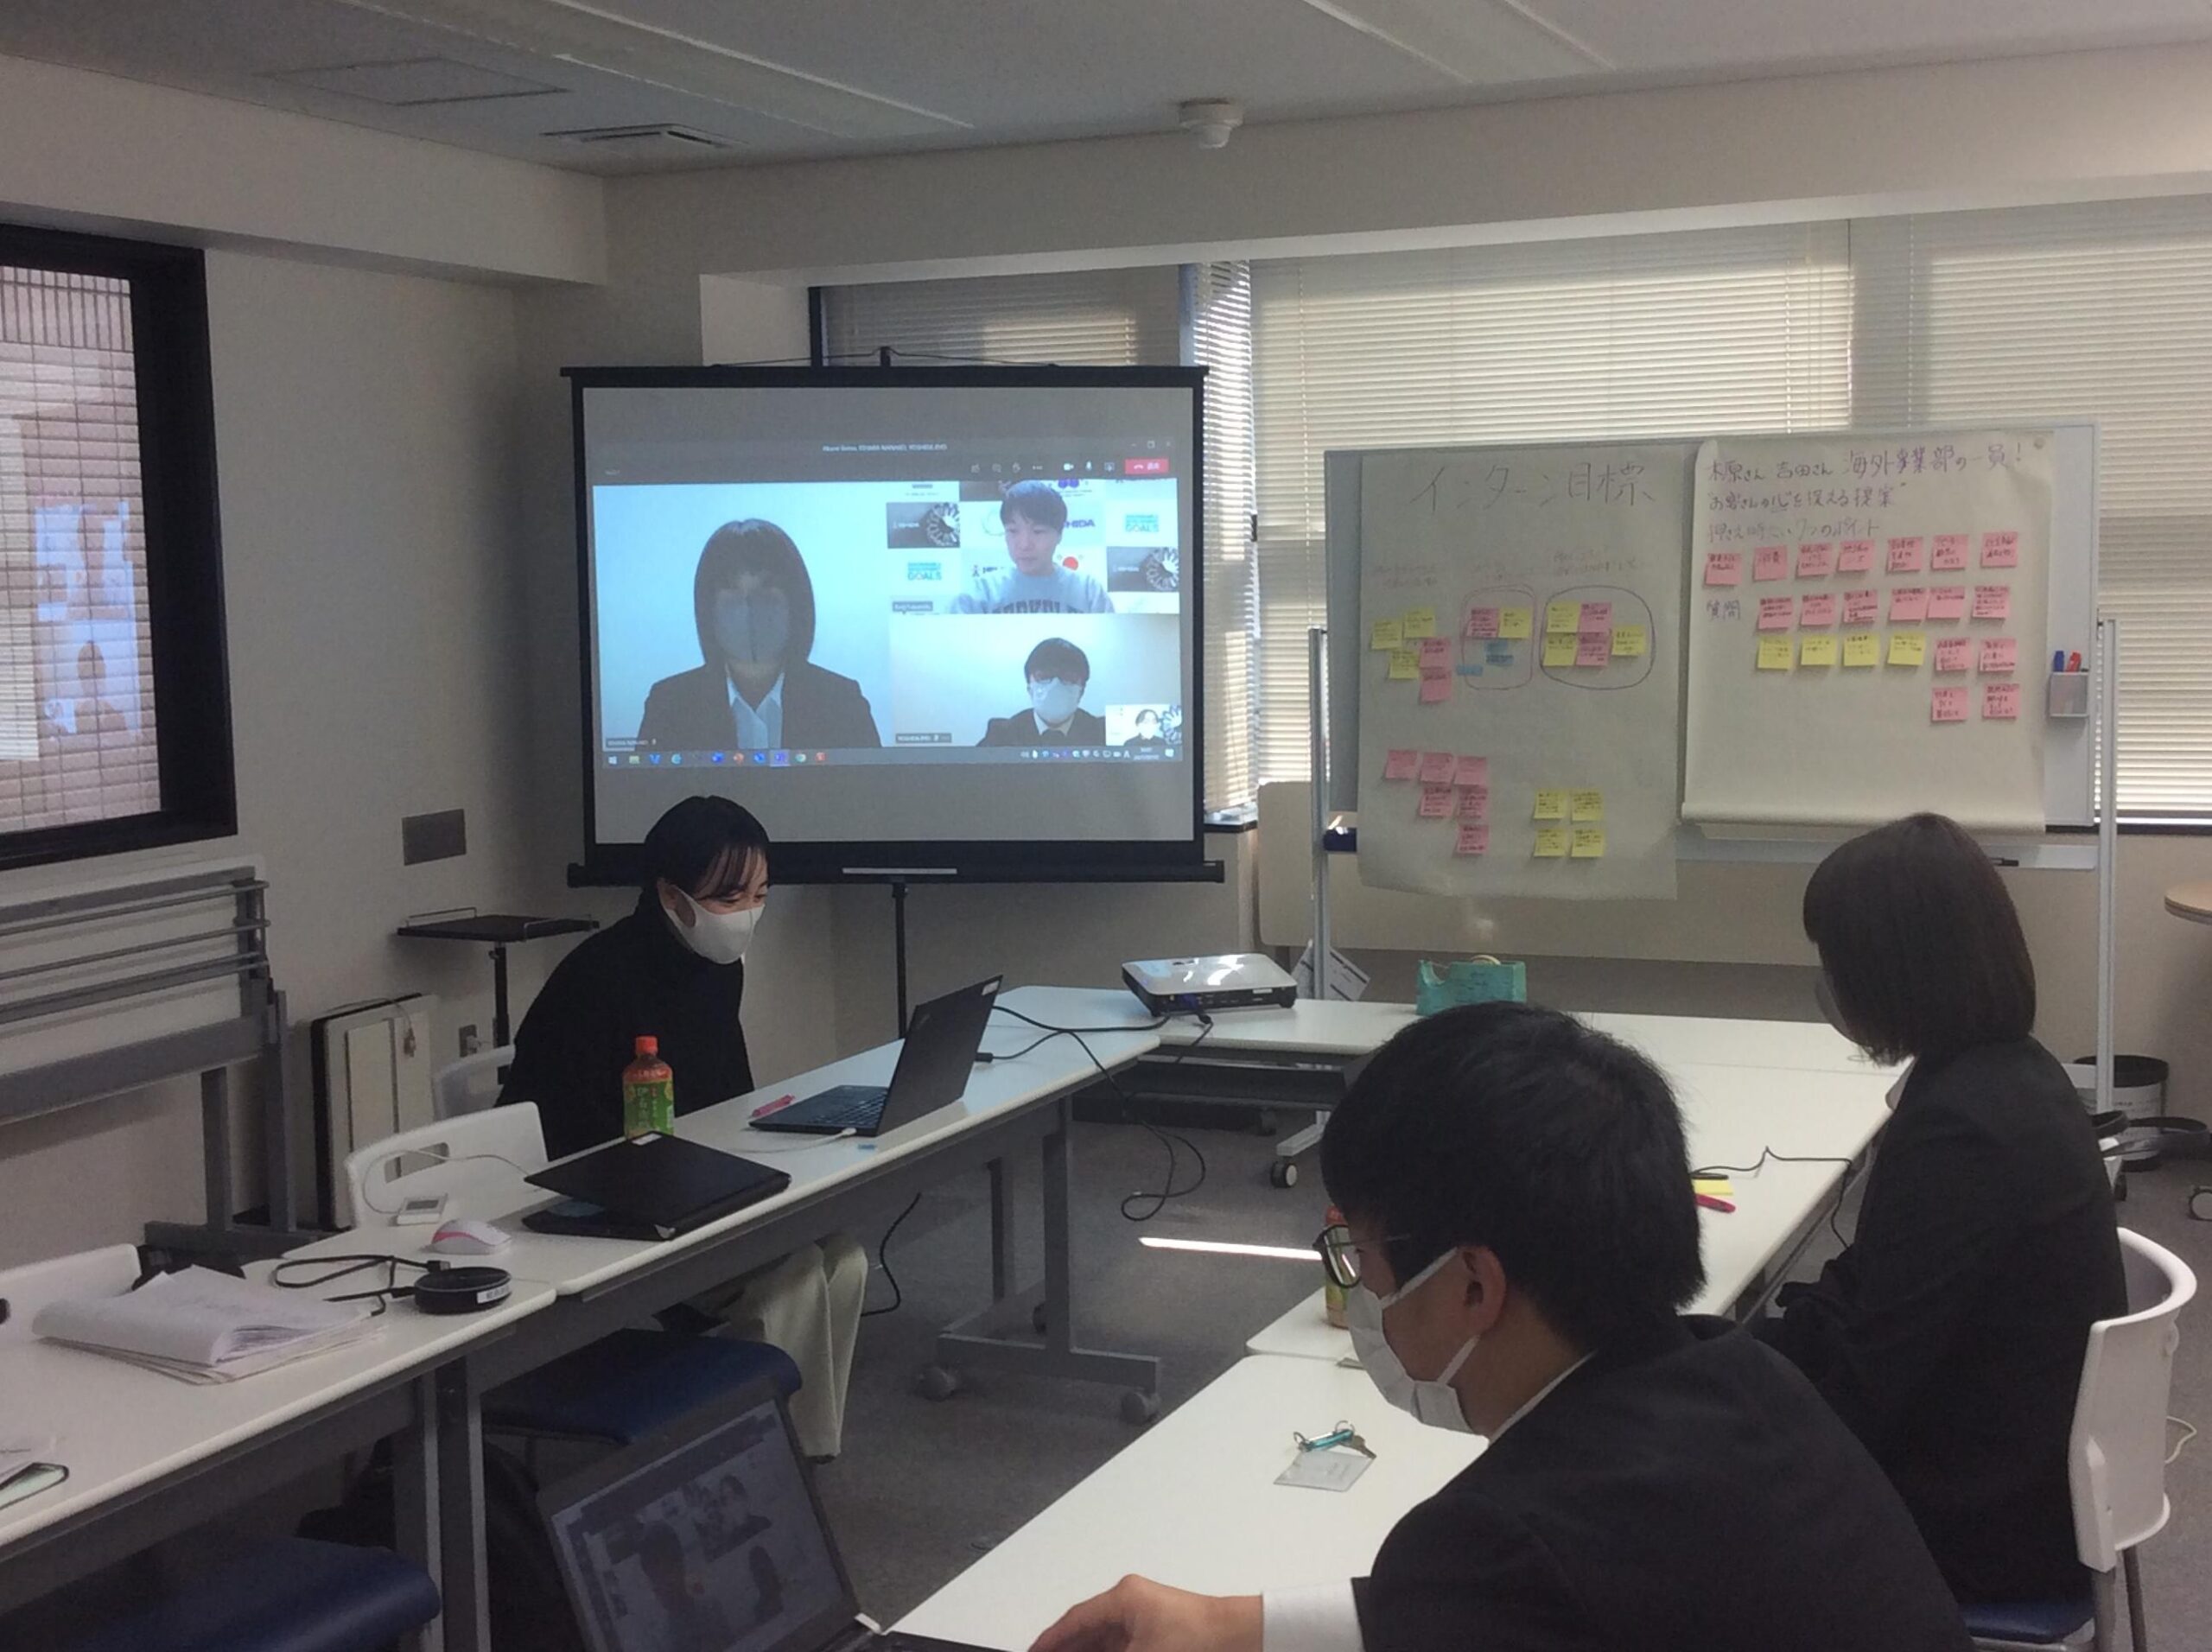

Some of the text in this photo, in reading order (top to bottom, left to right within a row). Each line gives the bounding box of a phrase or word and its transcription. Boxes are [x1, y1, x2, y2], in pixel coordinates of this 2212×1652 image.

[1409, 462, 1656, 511] インターン目標
